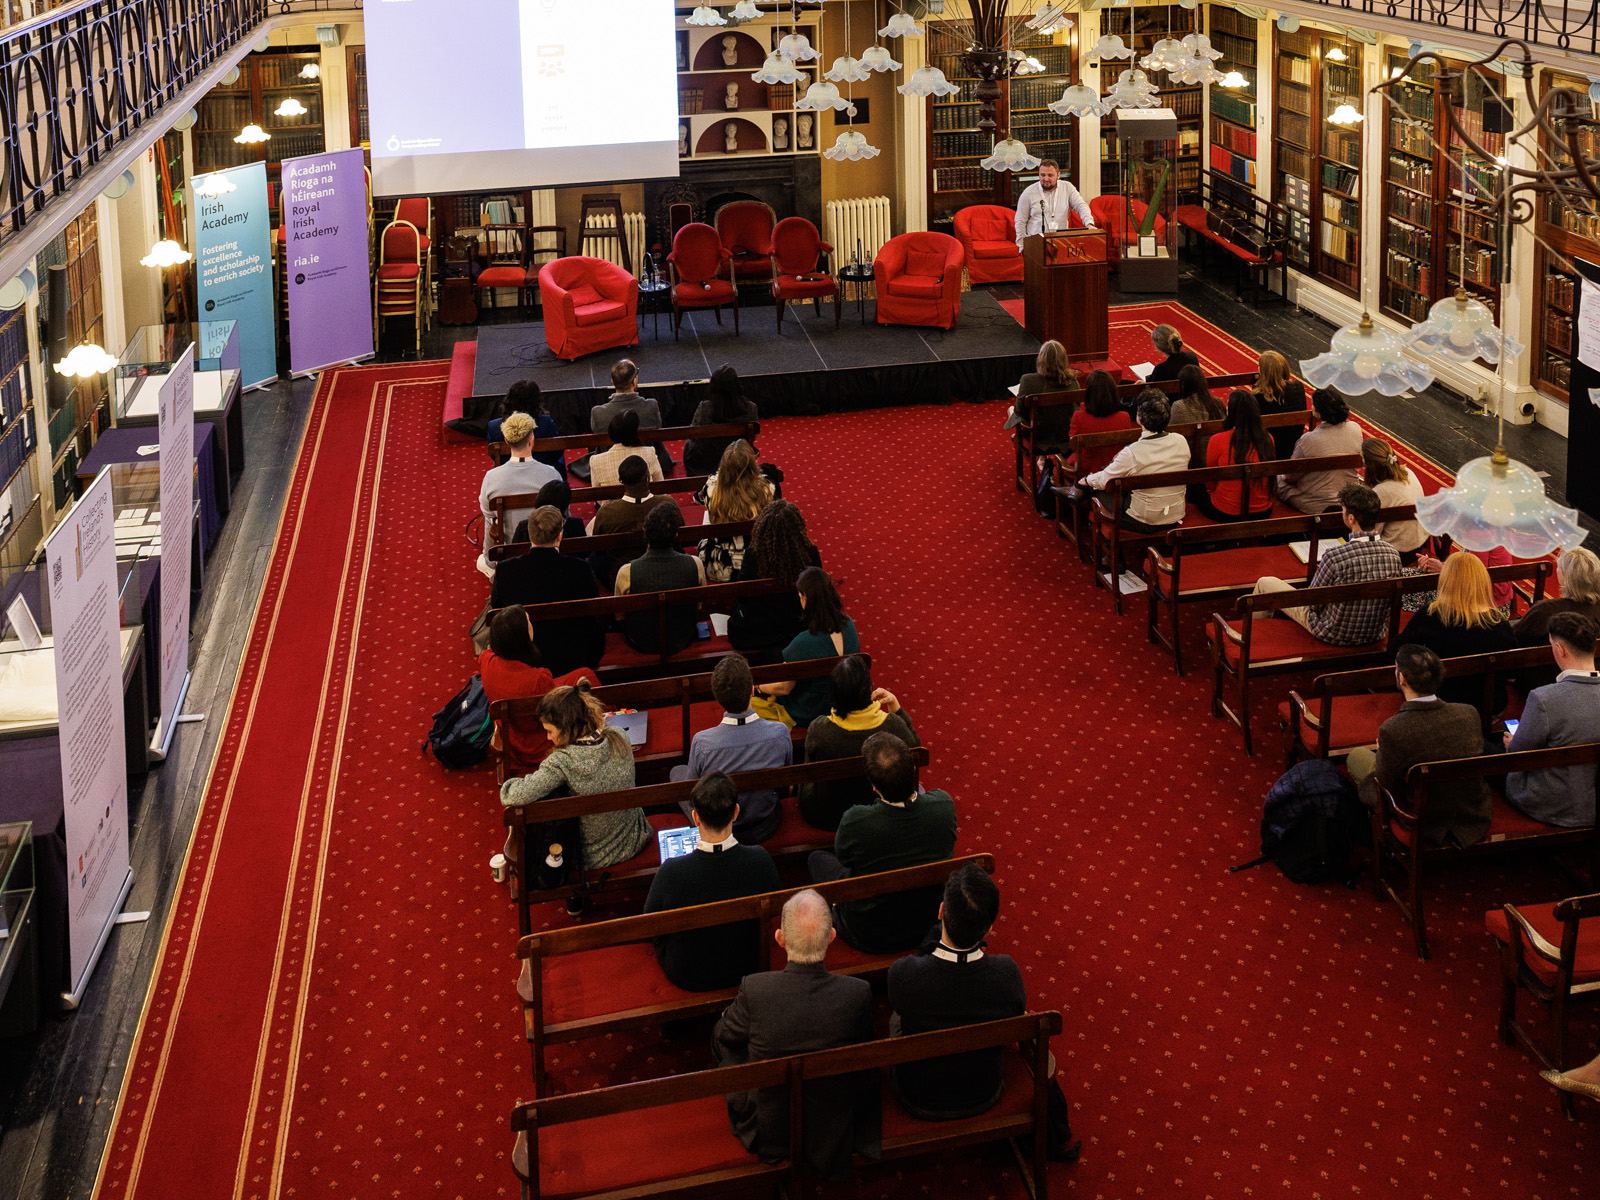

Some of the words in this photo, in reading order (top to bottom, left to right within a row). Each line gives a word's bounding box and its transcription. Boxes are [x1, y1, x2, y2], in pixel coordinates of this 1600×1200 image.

[290, 161, 337, 178] Acadamh
[291, 177, 319, 190] Ríoga
[321, 175, 334, 184] na
[291, 188, 335, 203] hÉireann
[201, 201, 224, 217] Irish
[292, 201, 321, 216] Royal
[201, 211, 249, 231] Academy
[293, 216, 315, 229] Irish
[293, 225, 339, 241] Academy
[202, 240, 238, 256] Fostering
[1067, 246, 1087, 258] RIA
[202, 250, 243, 266] excellence
[203, 264, 218, 277] and
[219, 254, 260, 272] scholarship
[294, 253, 320, 267] ria.ie
[203, 279, 213, 287] to
[213, 270, 238, 284] enrich
[238, 264, 265, 277] society
[81, 491, 108, 528] Collecting
[82, 509, 105, 542] Ireland's
[83, 526, 102, 556] History
